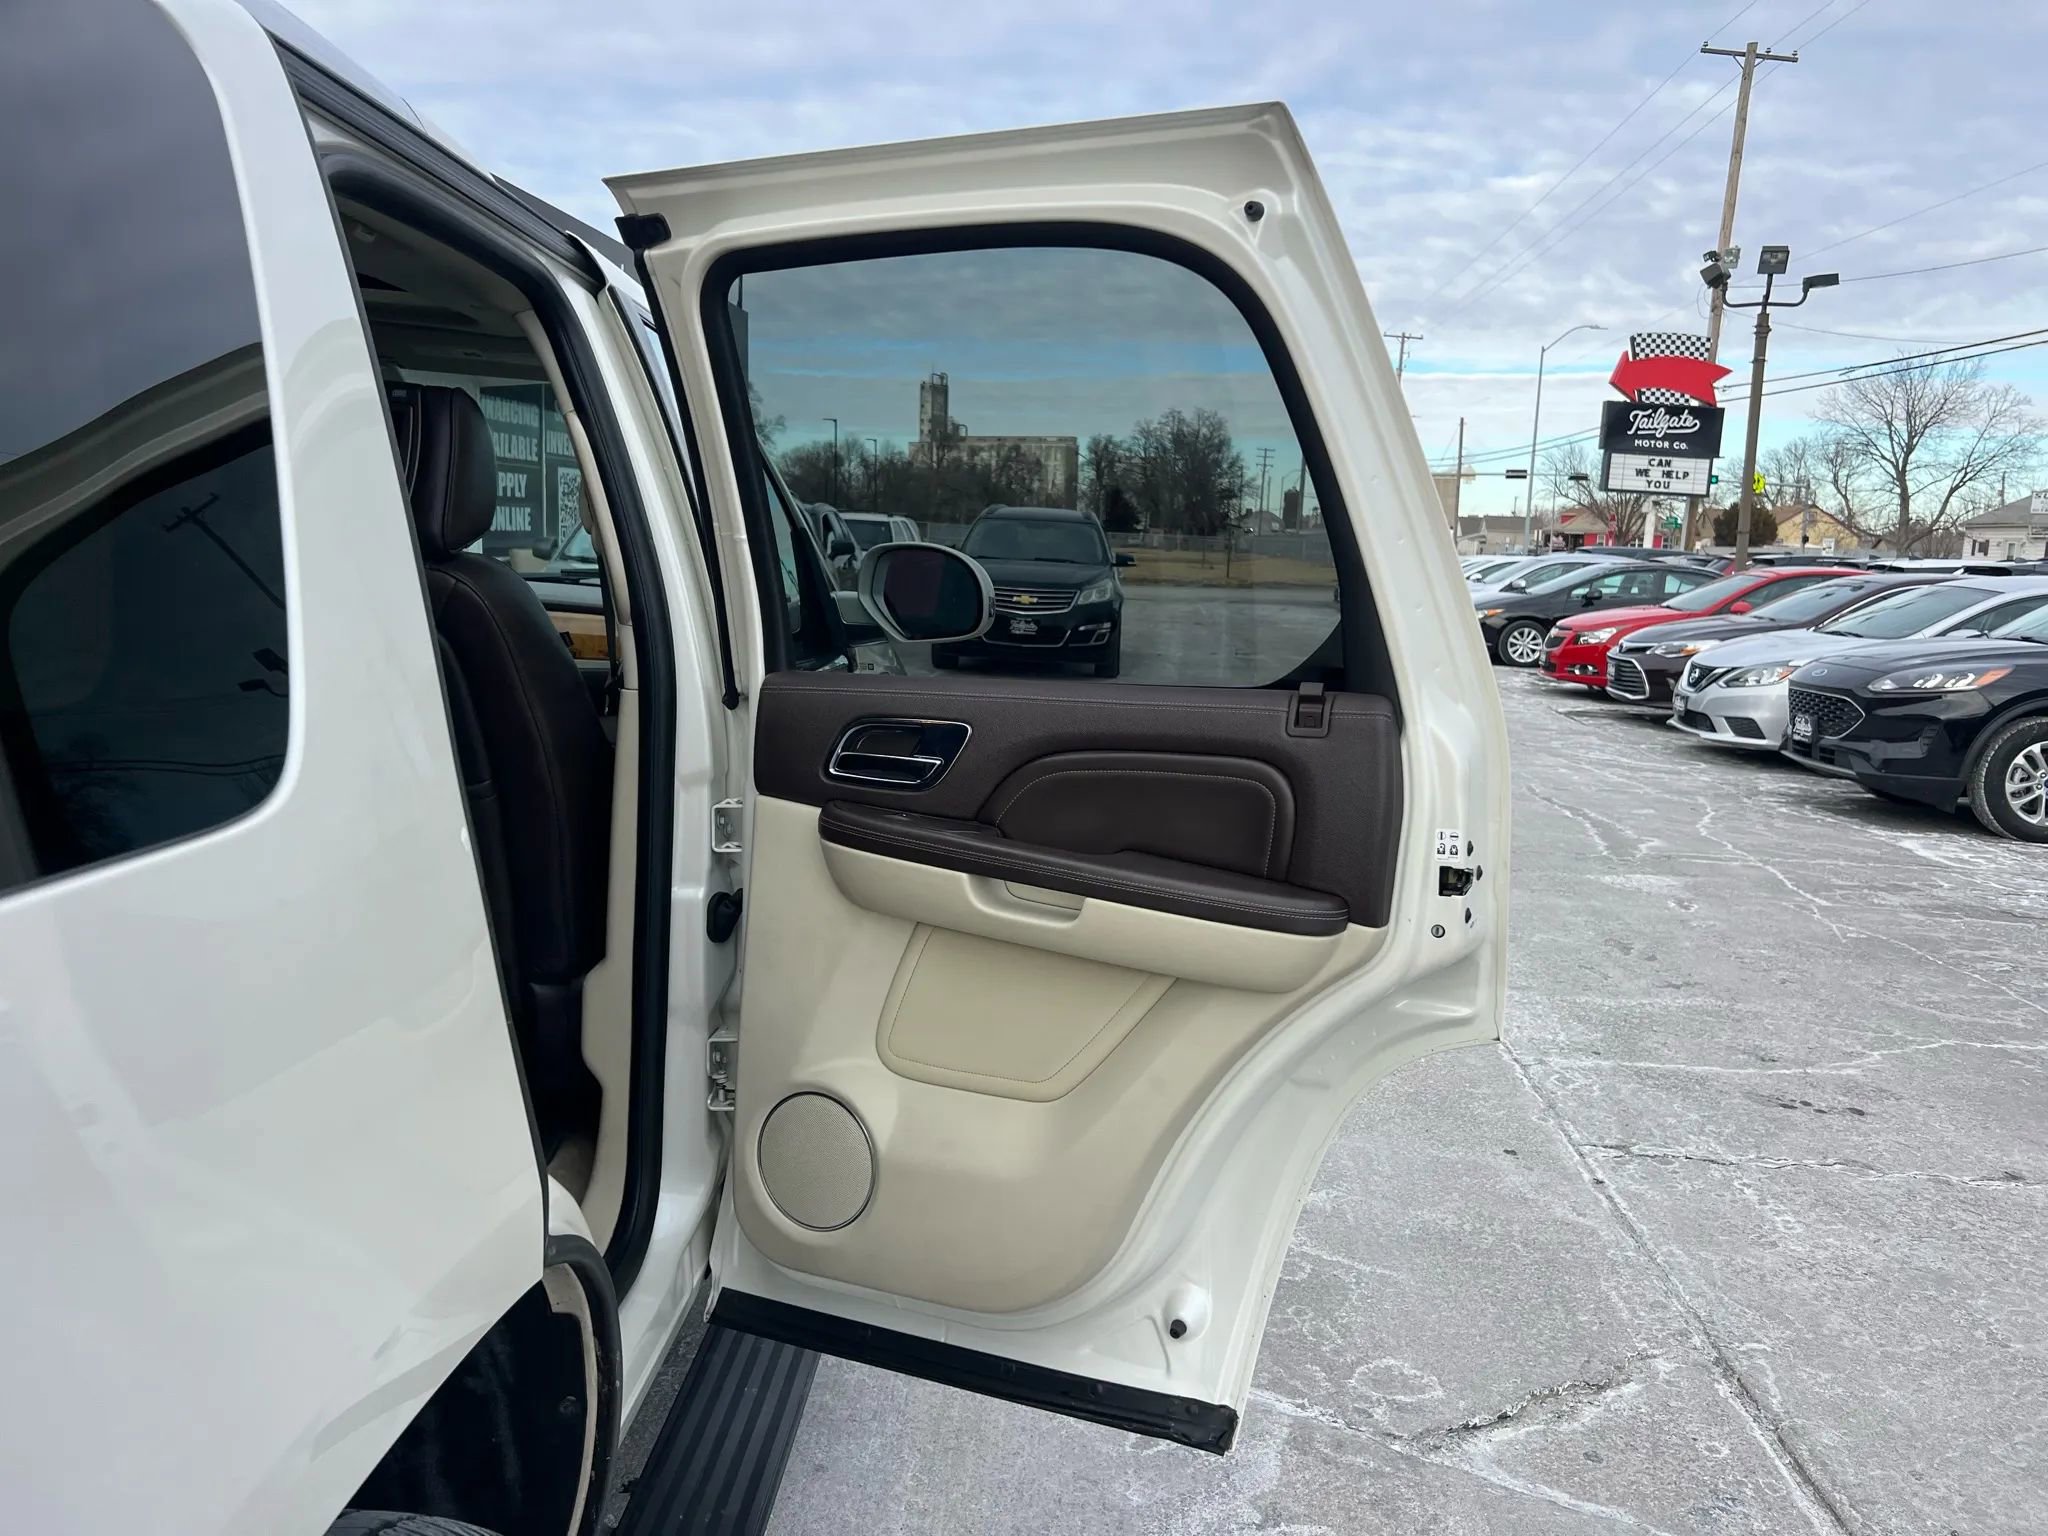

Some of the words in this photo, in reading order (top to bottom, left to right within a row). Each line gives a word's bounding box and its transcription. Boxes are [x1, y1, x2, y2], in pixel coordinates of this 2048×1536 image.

[480, 395, 540, 428] INANCING
[1627, 407, 1700, 438] Tailgate
[492, 431, 539, 462] AILABLE
[1634, 439, 1670, 449] MOTOR
[1648, 458, 1672, 468] CAN
[1635, 468, 1651, 478] WE
[1661, 470, 1690, 480] HELP
[1646, 479, 1670, 489] YOU
[497, 471, 528, 499] PPLY
